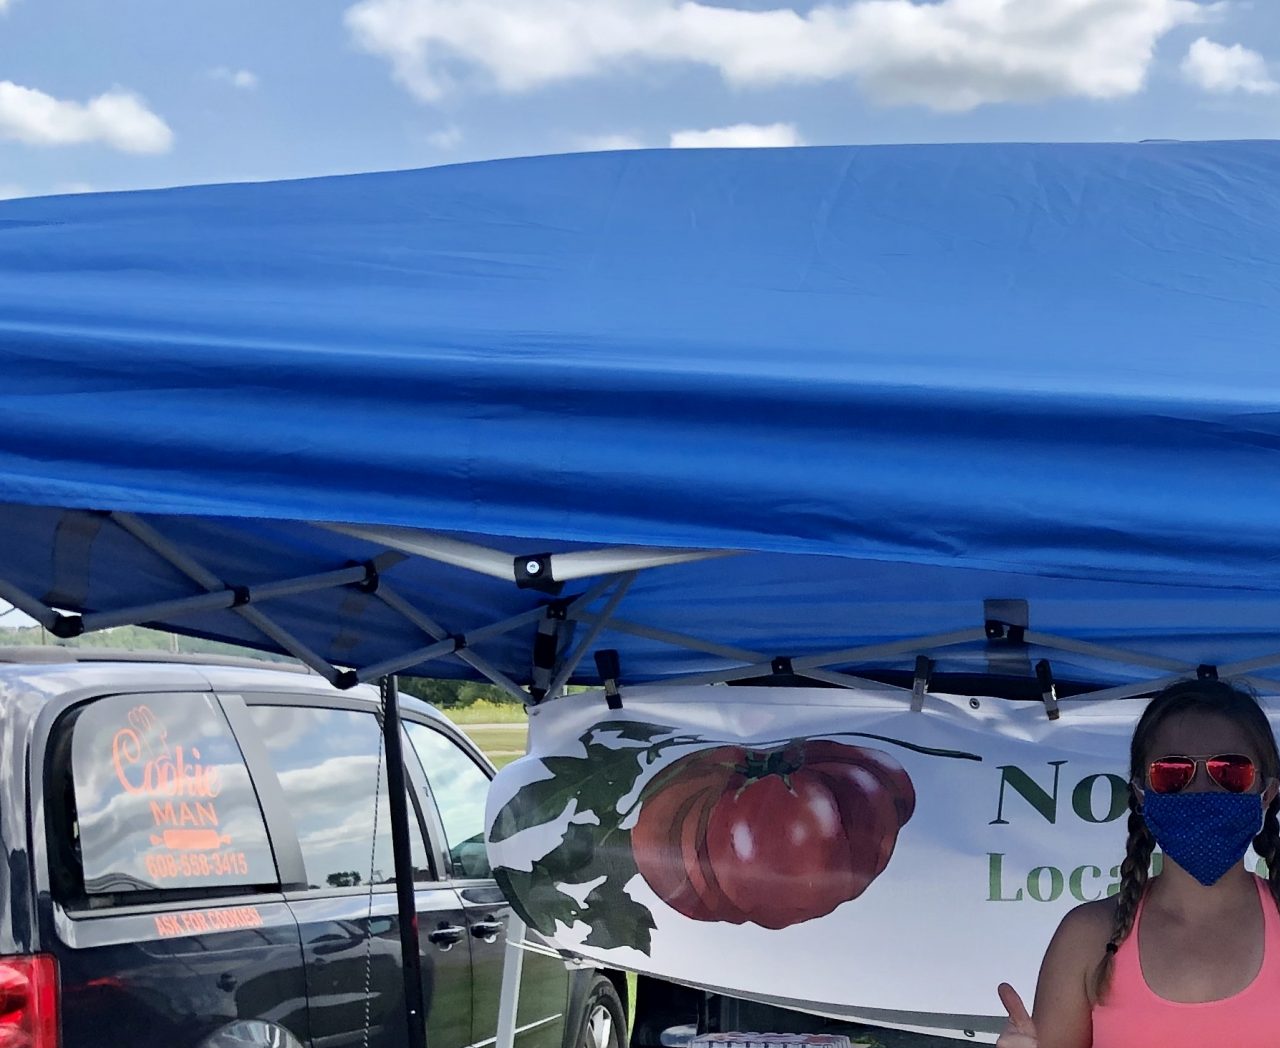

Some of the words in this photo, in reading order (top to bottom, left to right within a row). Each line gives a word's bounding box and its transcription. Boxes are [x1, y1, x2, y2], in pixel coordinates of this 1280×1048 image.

[112, 728, 221, 798] Cookie
[150, 800, 219, 827] MAN
[155, 914, 183, 936] ASK
[181, 911, 208, 933] FOR
